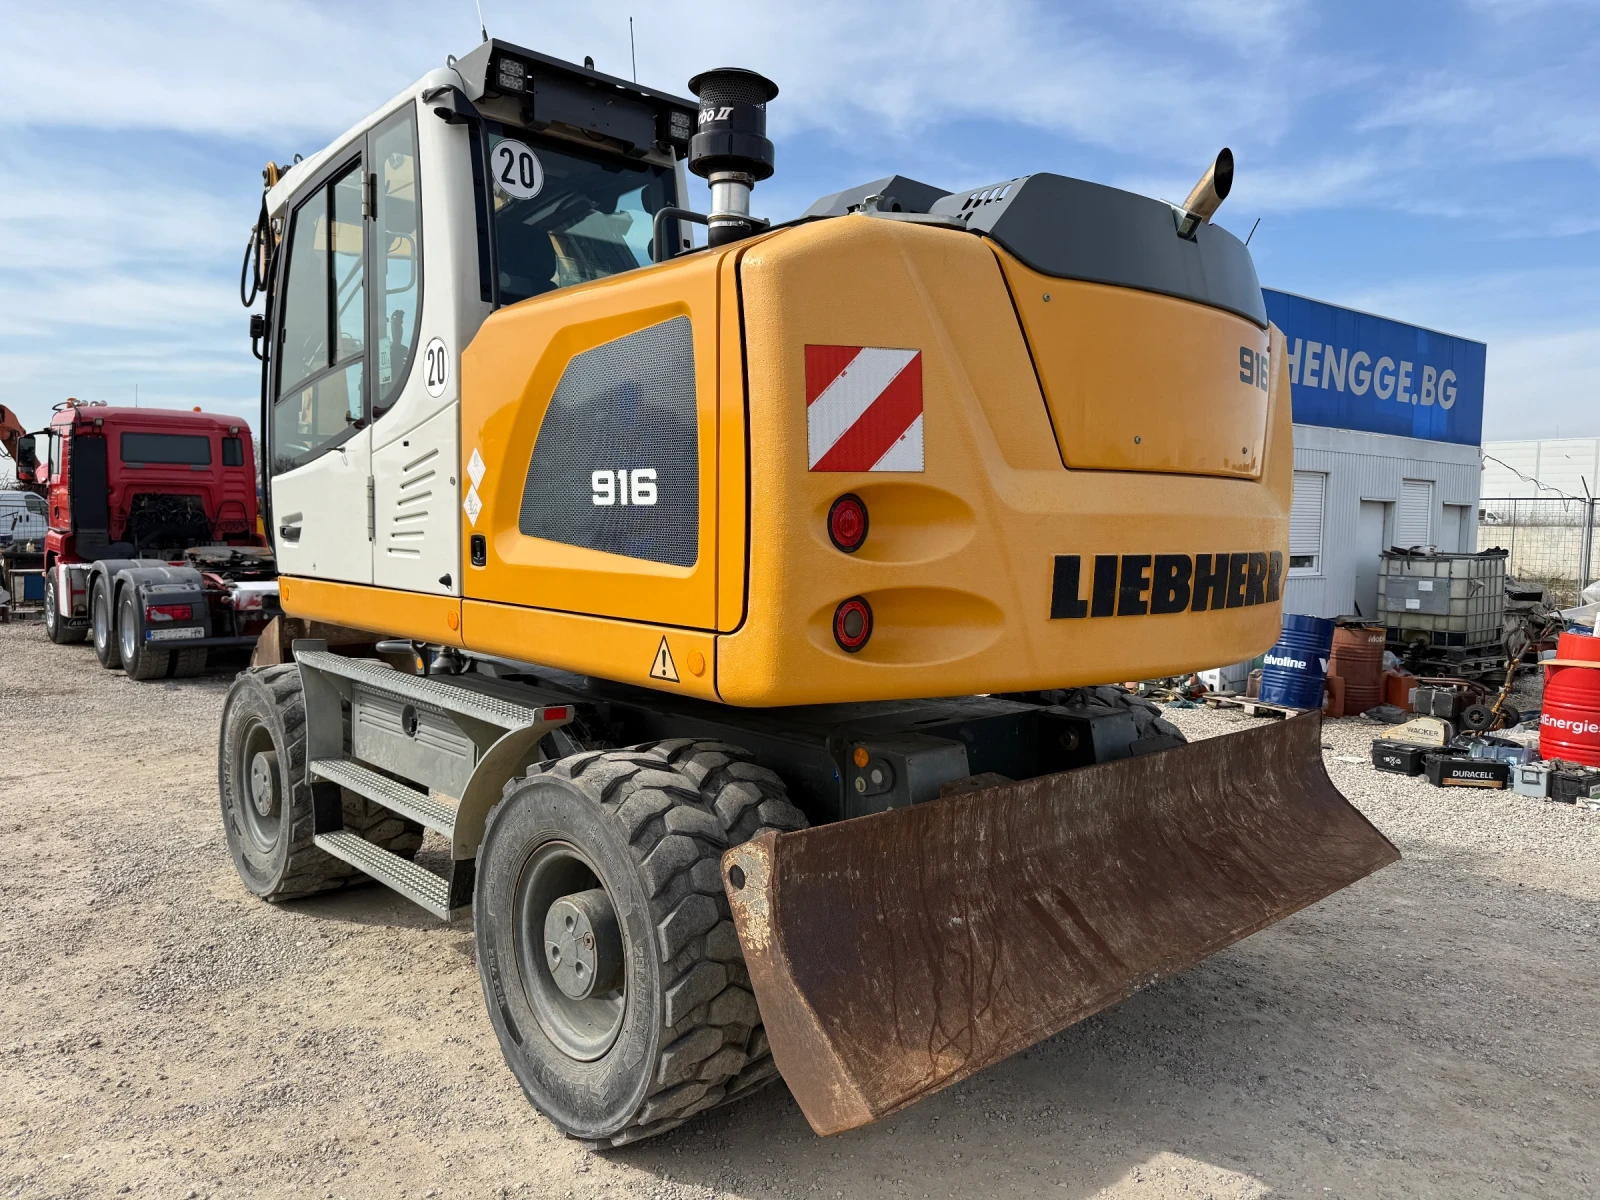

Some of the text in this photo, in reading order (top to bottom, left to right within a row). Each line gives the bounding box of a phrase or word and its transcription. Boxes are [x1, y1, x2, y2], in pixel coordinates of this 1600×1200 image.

[714, 106, 735, 121] II
[499, 147, 535, 190] 20
[427, 346, 446, 387] 20
[1239, 346, 1269, 393] 916
[591, 468, 658, 506] 916
[1050, 550, 1283, 619] LIEBHERR
[1406, 726, 1440, 737] WACKER
[1452, 769, 1494, 780] DURACELL
